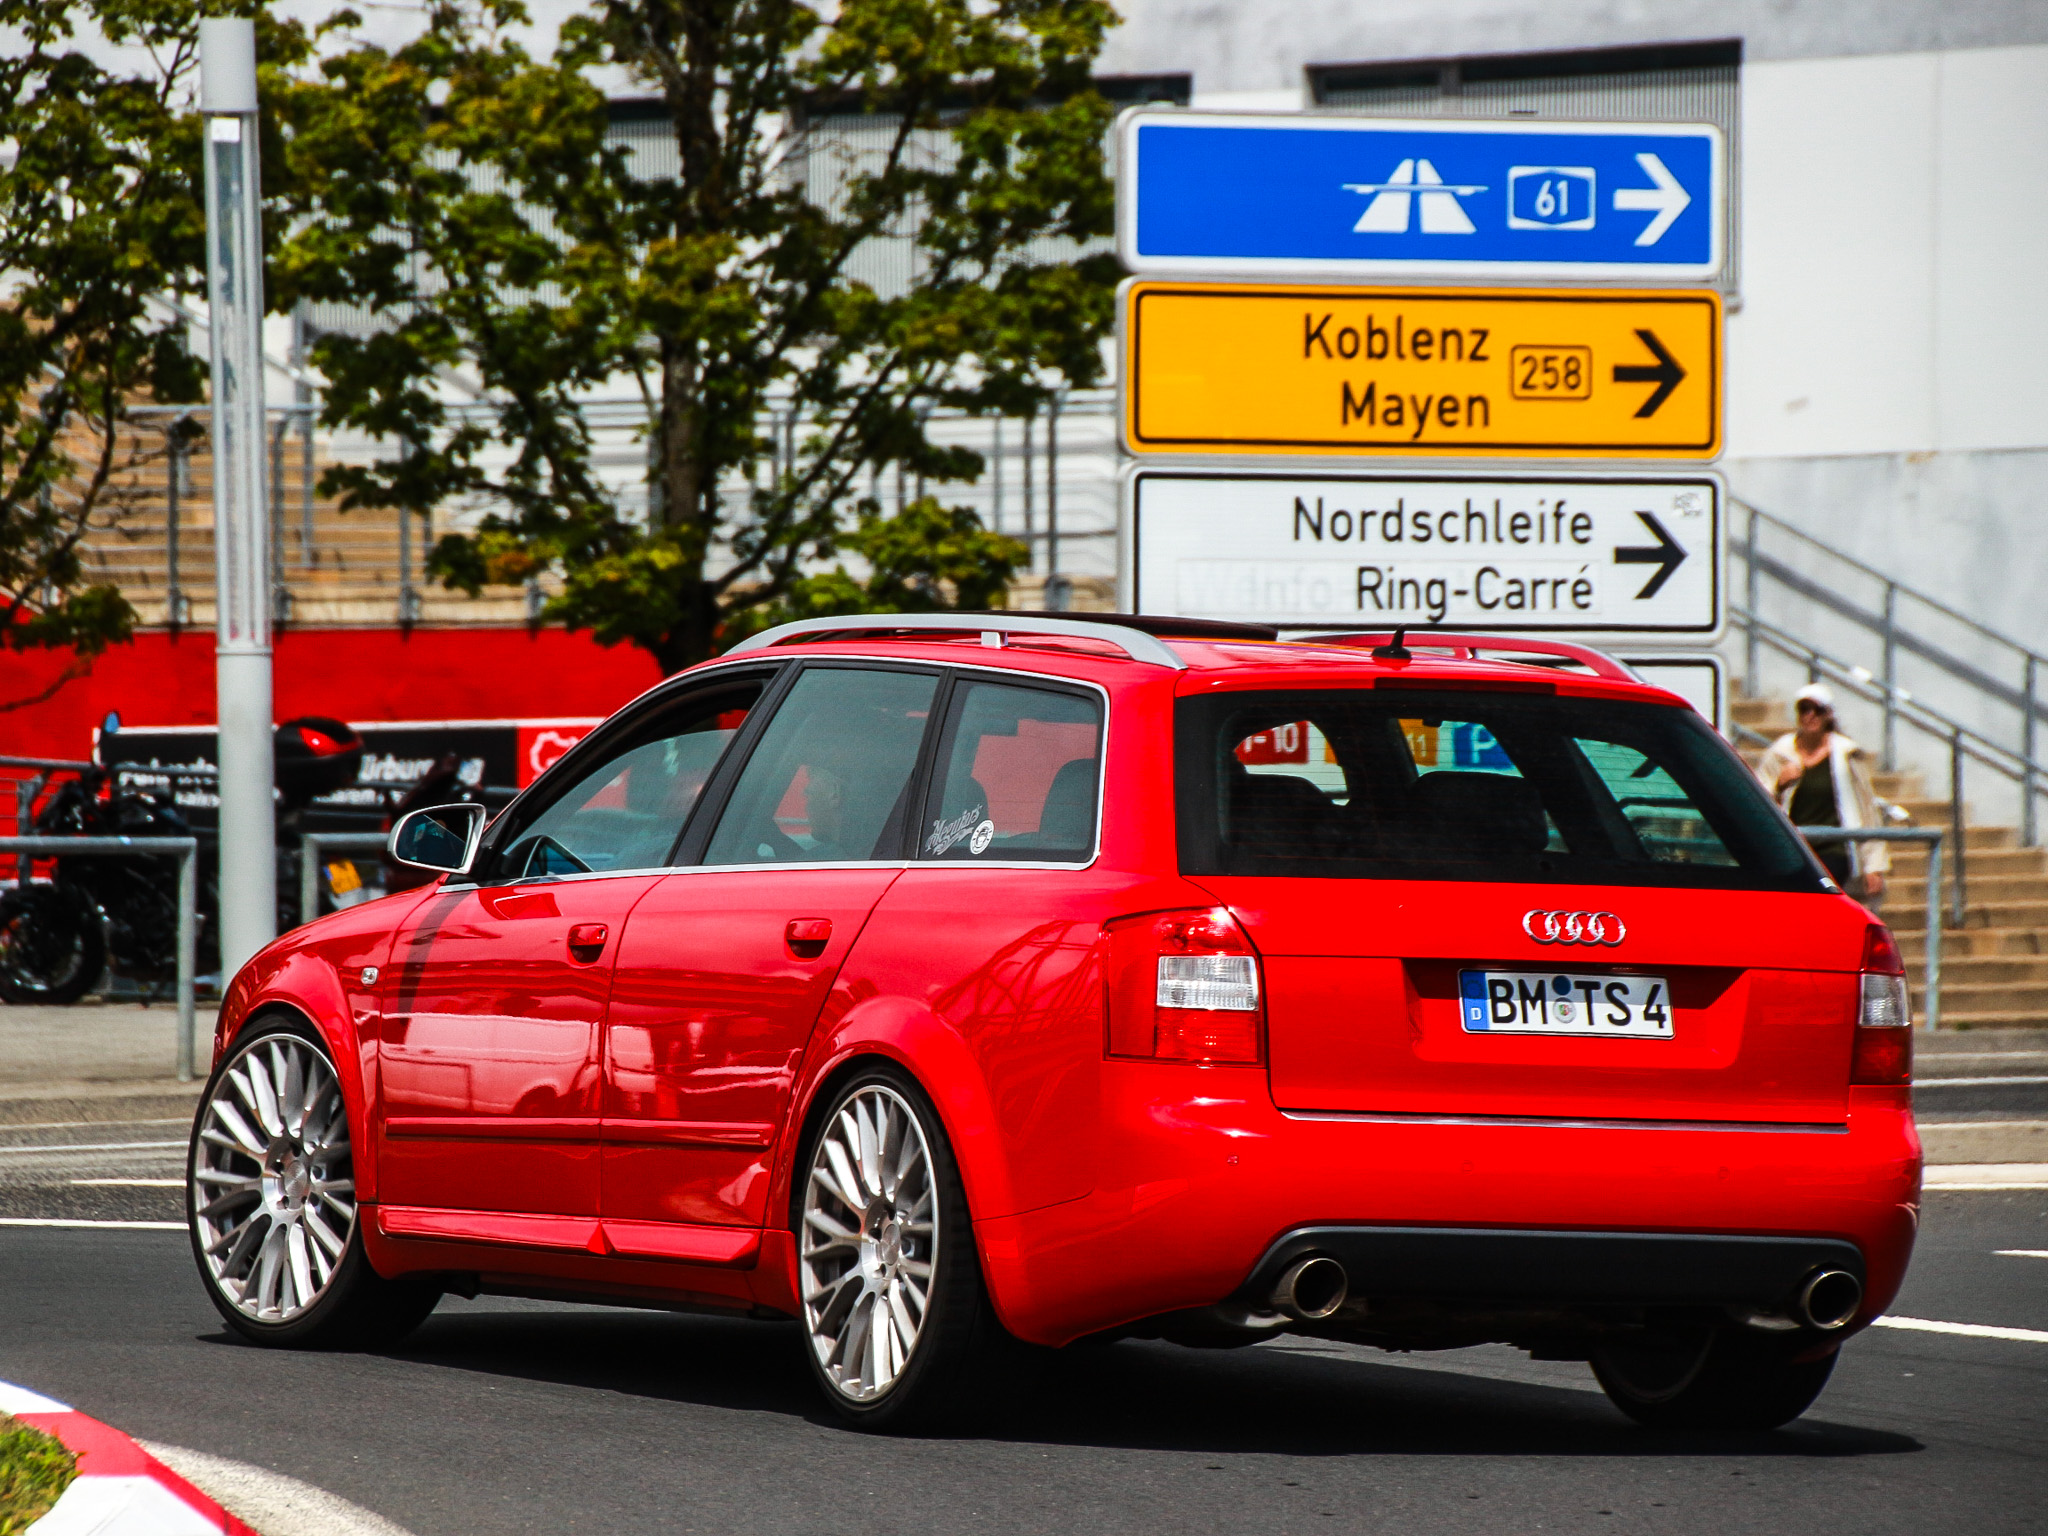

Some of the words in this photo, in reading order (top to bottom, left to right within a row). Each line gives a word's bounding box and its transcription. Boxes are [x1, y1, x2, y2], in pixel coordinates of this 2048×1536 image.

[1534, 179, 1569, 218] 61
[1302, 312, 1491, 362] Koblenz
[1519, 354, 1583, 392] 258
[1340, 381, 1491, 440] Mayen
[1293, 496, 1594, 545] Nordschleife
[1355, 563, 1594, 623] Ring-Carré
[1471, 724, 1498, 764] P
[1471, 1006, 1483, 1021] D
[1487, 978, 1548, 1025] BM
[1573, 979, 1632, 1027] TS
[1643, 983, 1668, 1030] 4
